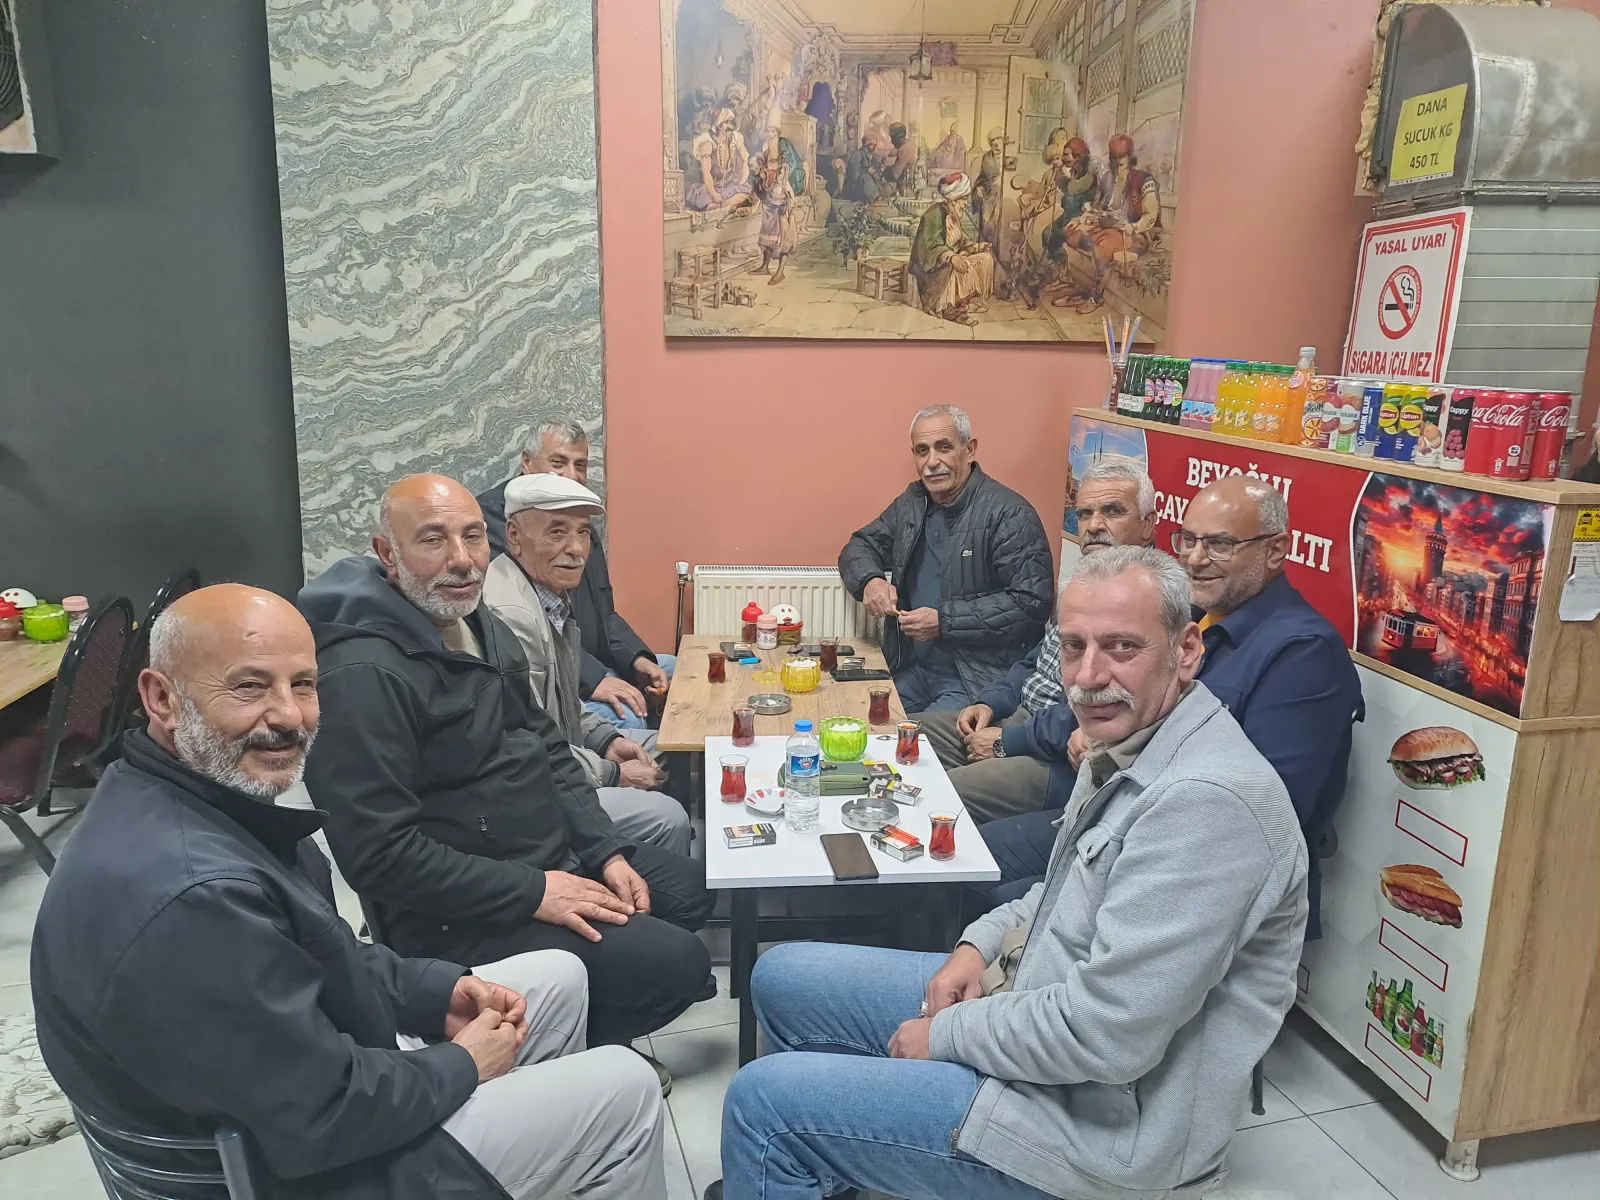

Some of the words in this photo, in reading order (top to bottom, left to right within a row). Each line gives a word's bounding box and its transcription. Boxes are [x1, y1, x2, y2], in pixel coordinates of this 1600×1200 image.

[1417, 97, 1448, 117] DANA
[1403, 125, 1438, 146] SUCUK
[1439, 122, 1454, 139] KG
[1409, 154, 1428, 170] 450
[1430, 152, 1439, 167] TL
[1375, 238, 1408, 256] YASAL
[1411, 232, 1448, 252] UYARI
[1362, 395, 1372, 414] BLUE
[1449, 406, 1470, 416] Cappy
[1359, 415, 1368, 435] DARK
[1154, 490, 1189, 525] ÇAY
